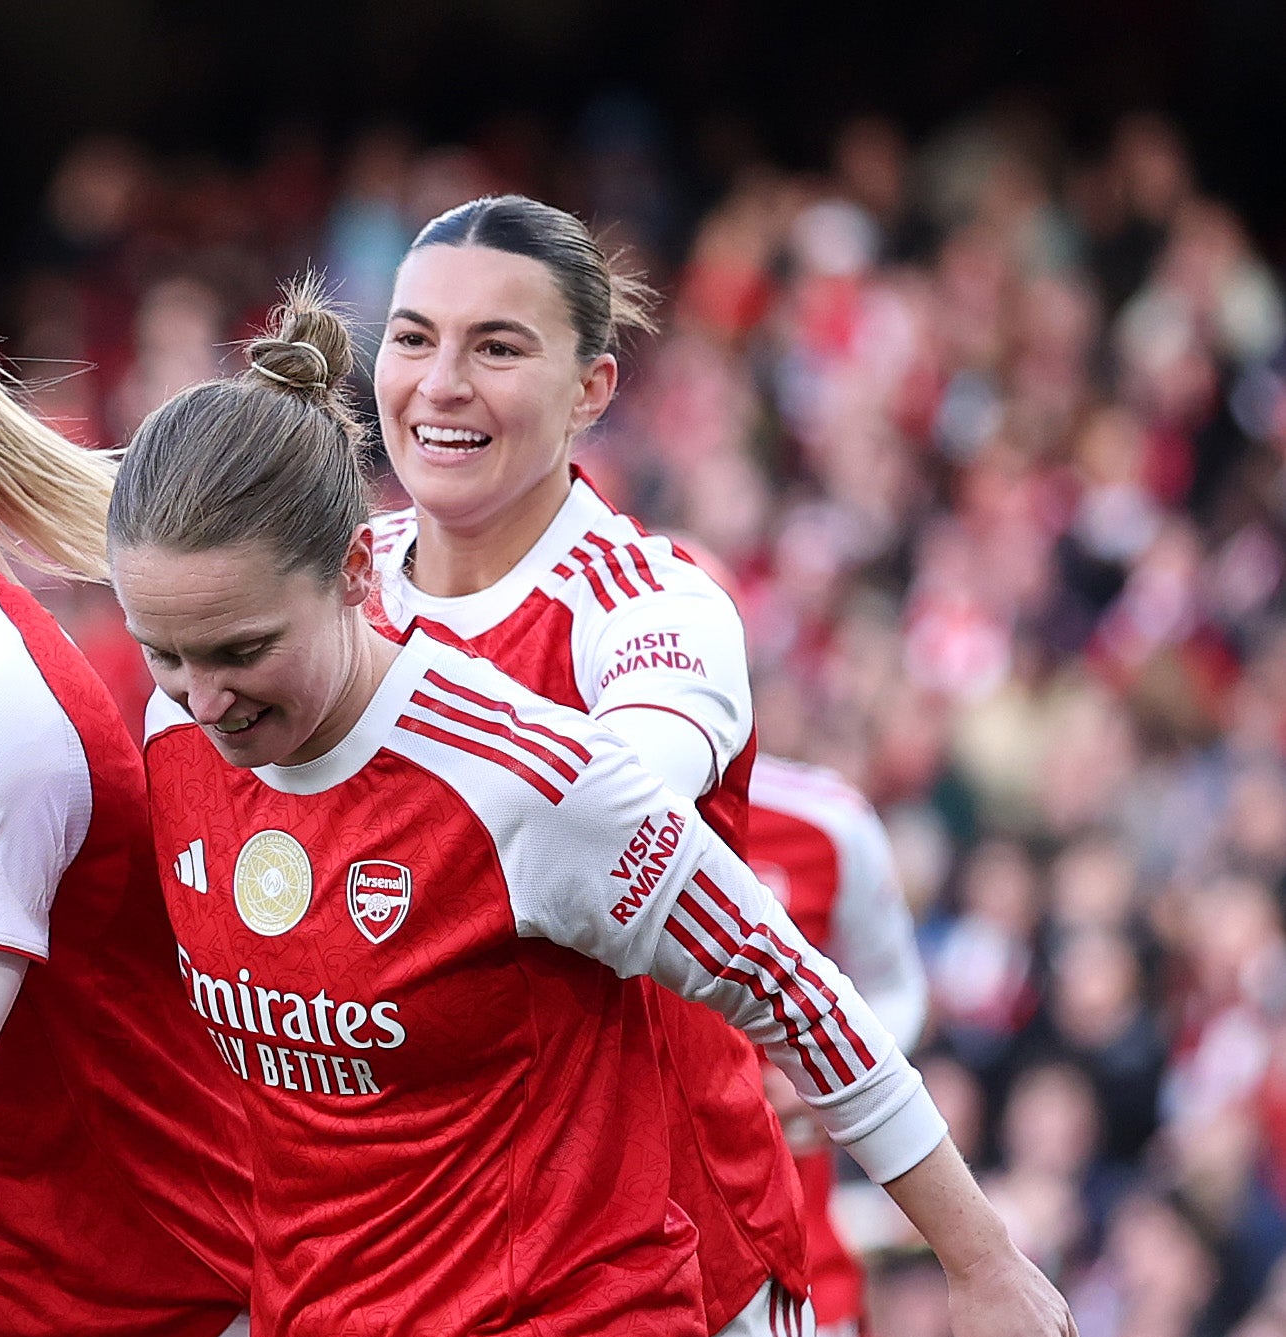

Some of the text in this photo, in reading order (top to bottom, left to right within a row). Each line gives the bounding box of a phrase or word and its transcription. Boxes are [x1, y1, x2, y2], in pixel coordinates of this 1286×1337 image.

[609, 814, 657, 880] VISIT
[609, 810, 686, 926] RWANDA
[356, 873, 403, 890] Arsenal
[256, 1042, 381, 1096] BETTER
